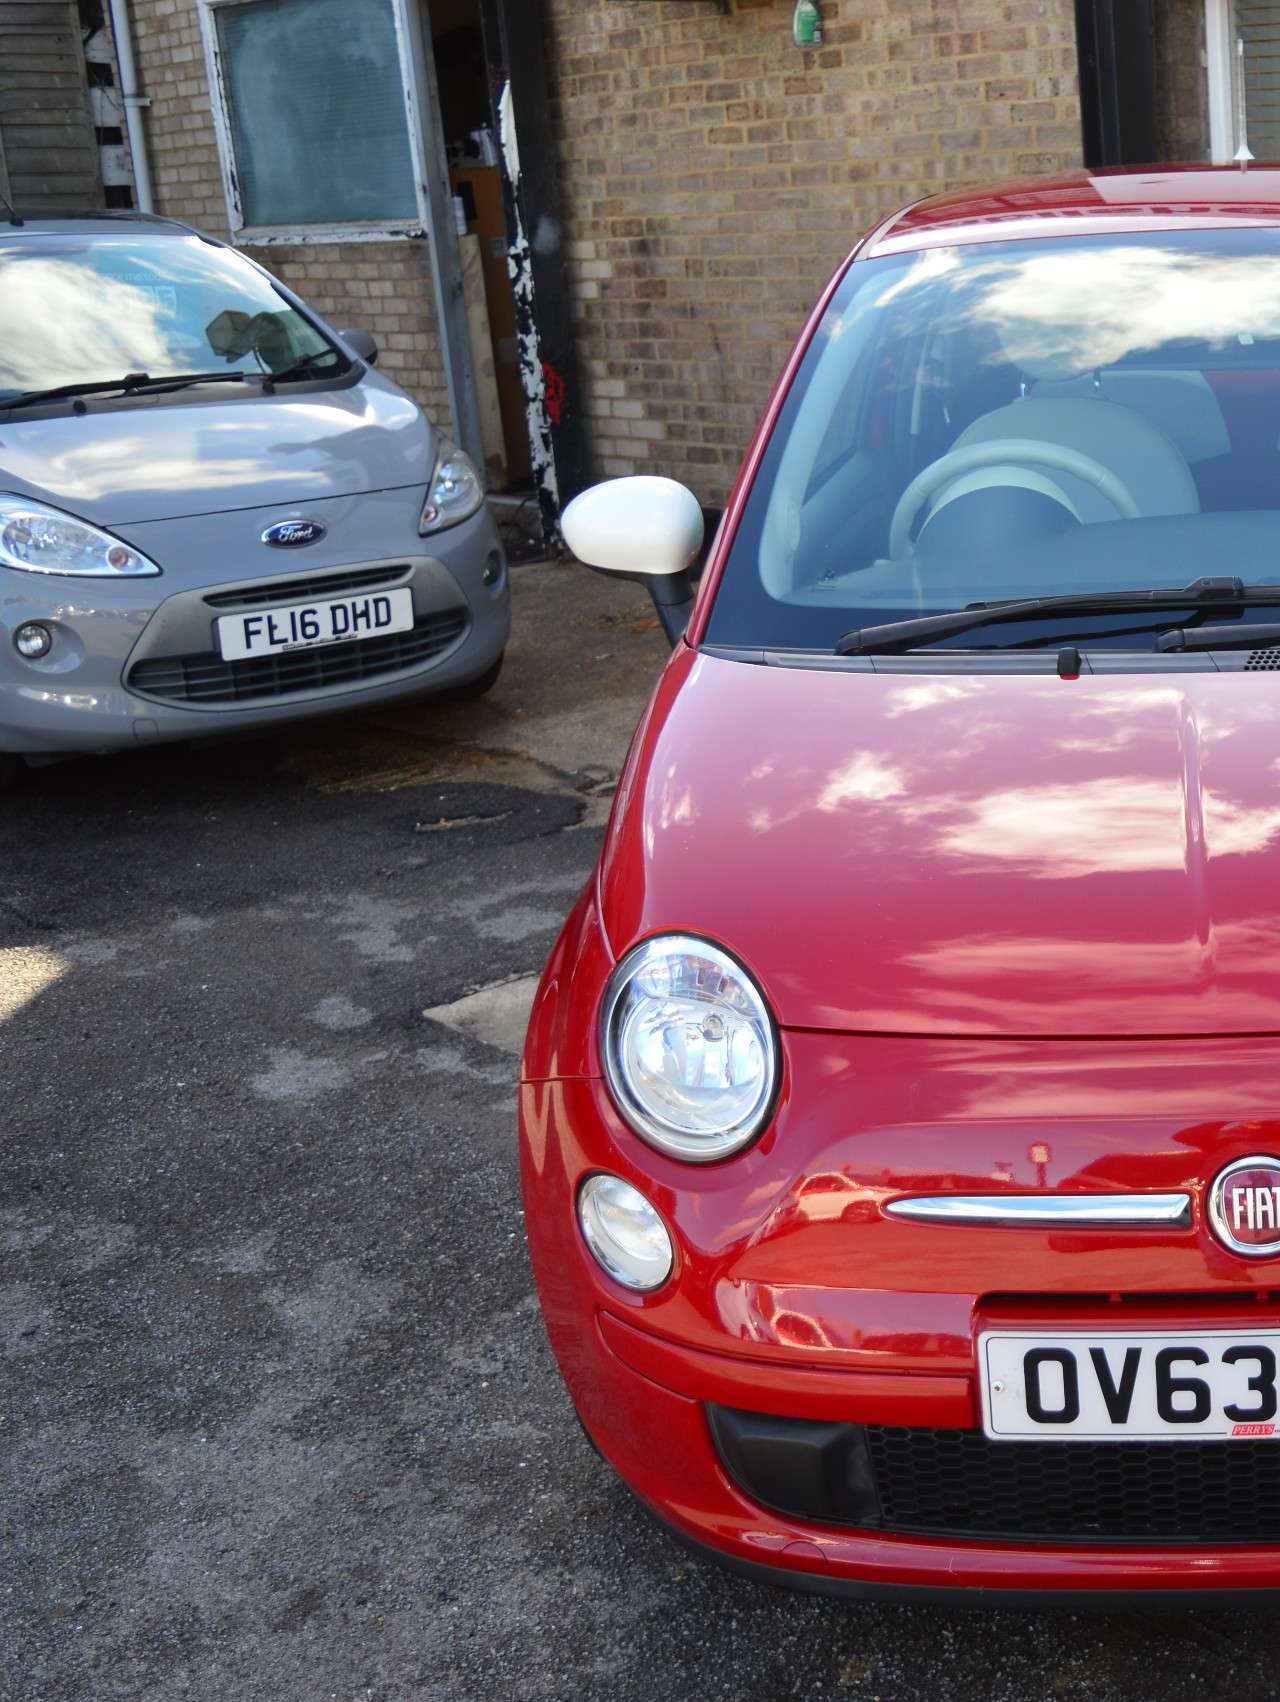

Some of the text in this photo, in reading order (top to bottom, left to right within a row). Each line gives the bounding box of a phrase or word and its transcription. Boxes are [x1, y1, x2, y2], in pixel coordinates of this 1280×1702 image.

[278, 524, 314, 542] Ford
[243, 596, 392, 650] FL16 DHD
[1023, 1344, 1278, 1424] OV63
[1233, 1425, 1274, 1434] PERRYS
